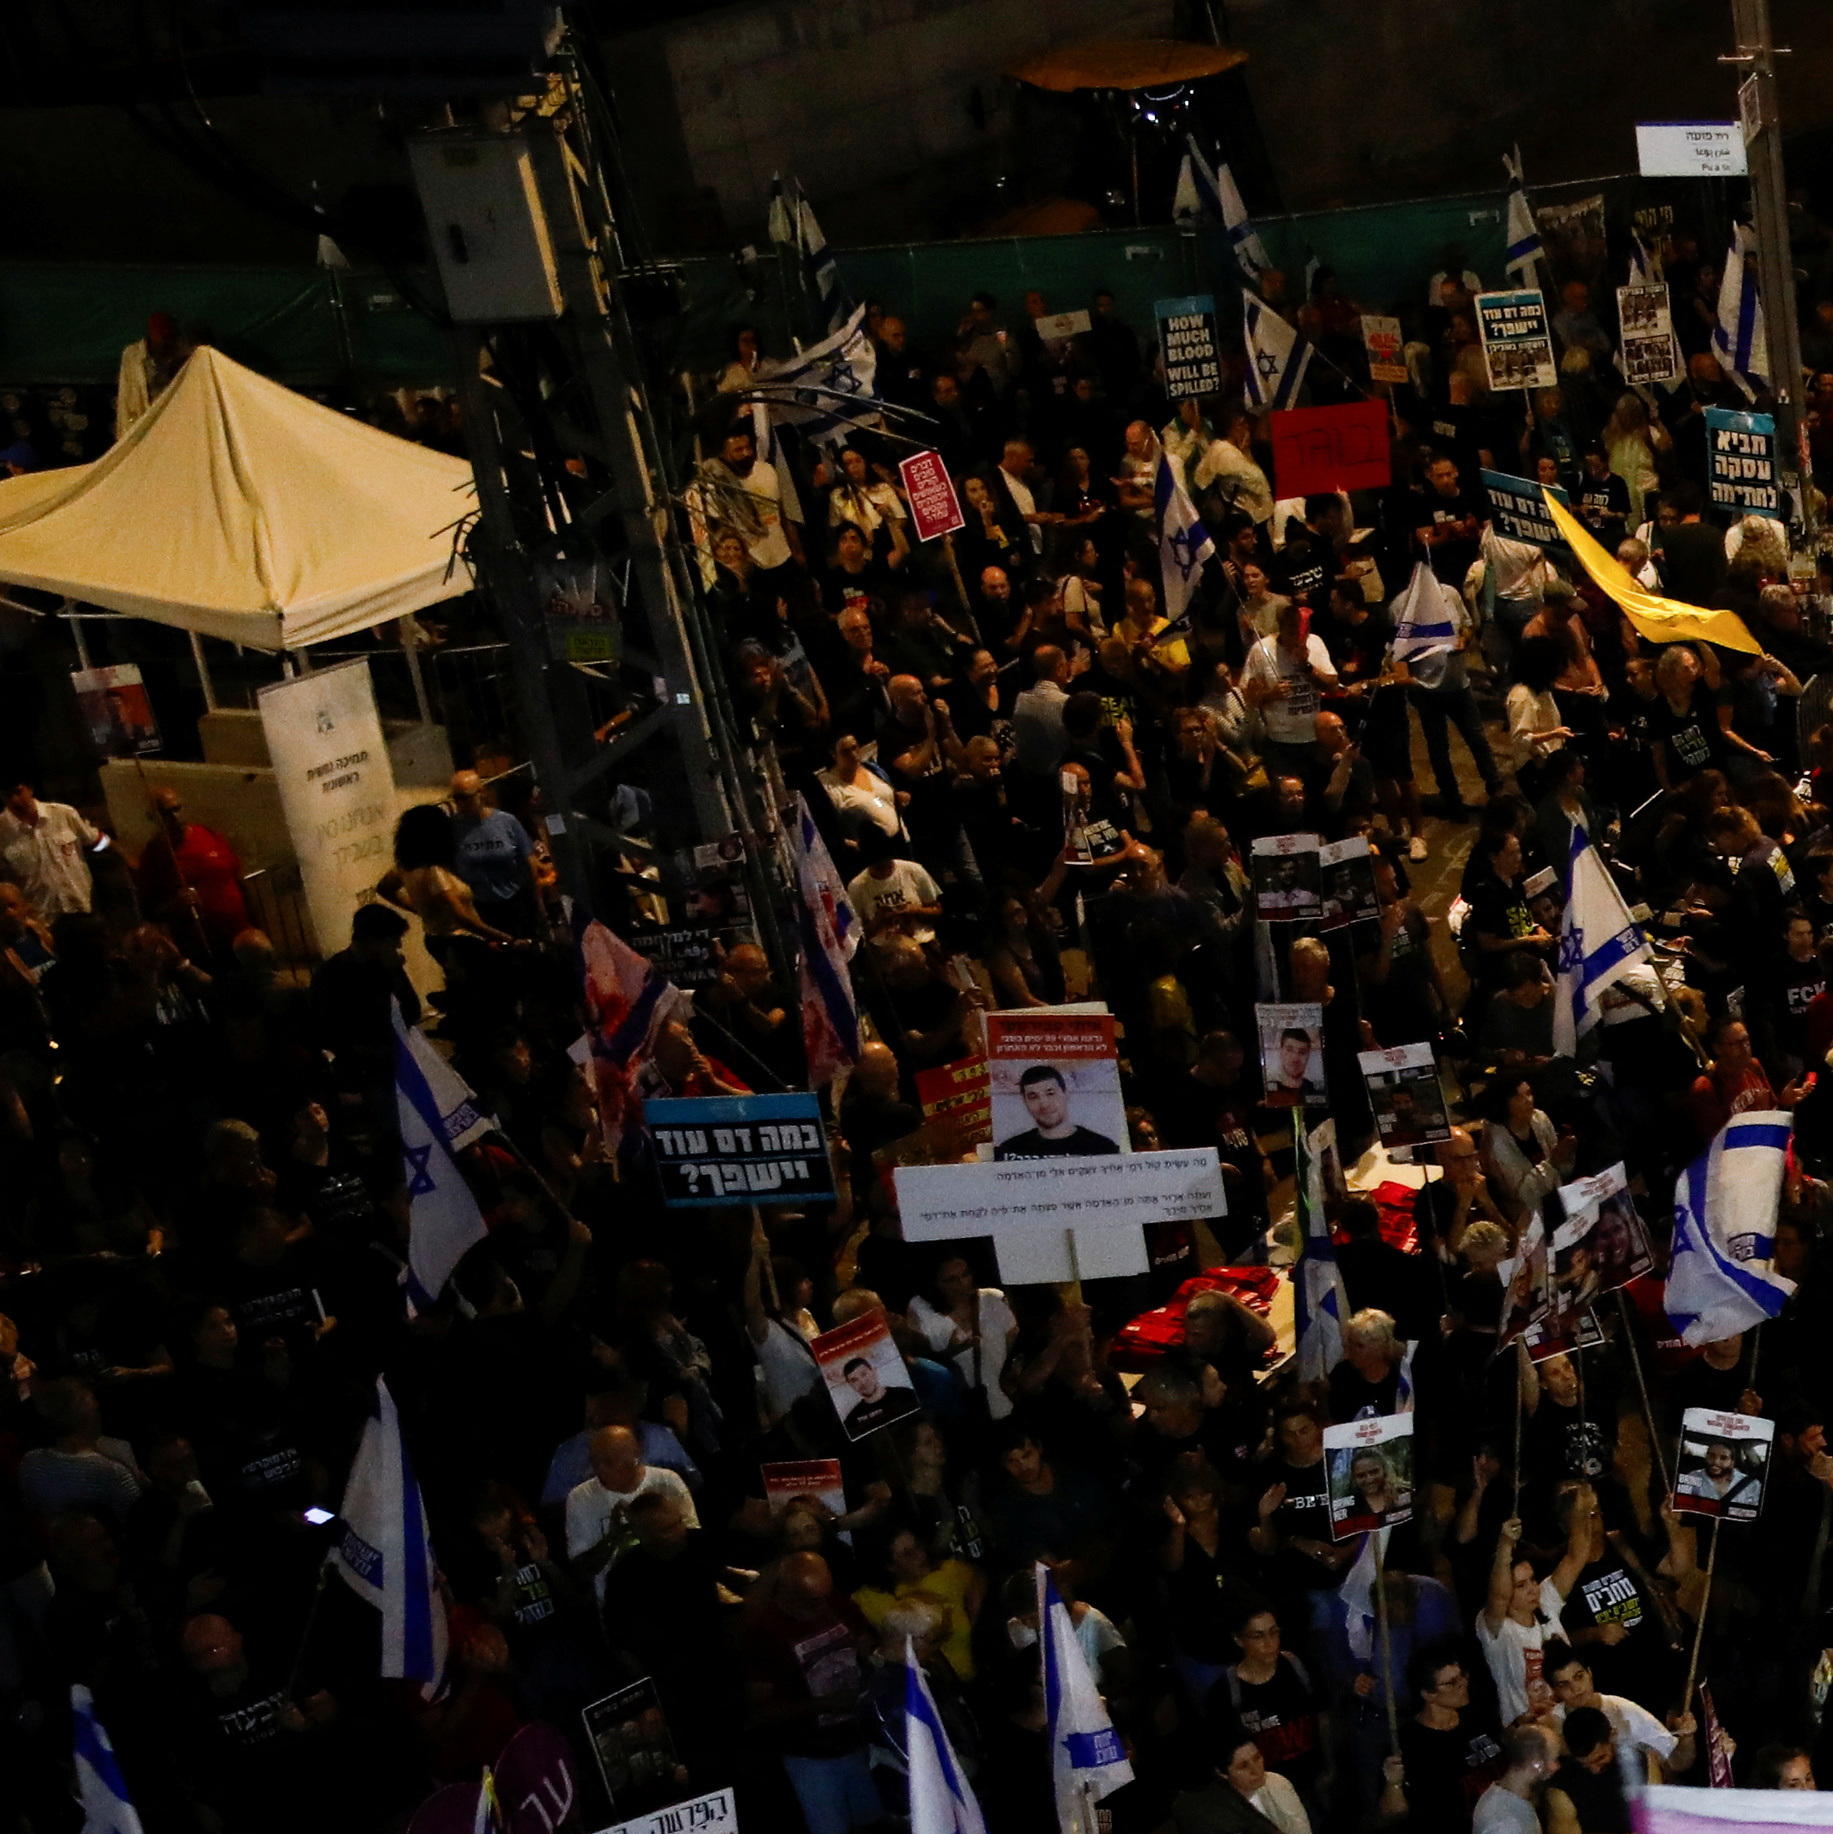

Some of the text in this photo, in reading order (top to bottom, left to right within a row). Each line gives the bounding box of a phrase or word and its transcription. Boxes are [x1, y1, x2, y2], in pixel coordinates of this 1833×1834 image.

[1168, 315, 1203, 332] HOW
[1167, 328, 1211, 346] MUCH
[1167, 345, 1214, 362] BLOOD
[1167, 361, 1219, 382] WILL BE
[1169, 378, 1220, 397] SPILLED?
[1716, 429, 1767, 455] תביא
[1714, 454, 1772, 480] עסקה
[1711, 481, 1777, 508] לחתימה
[655, 1124, 820, 1156] כמה דם עוד
[681, 1160, 810, 1197] יישפך?
